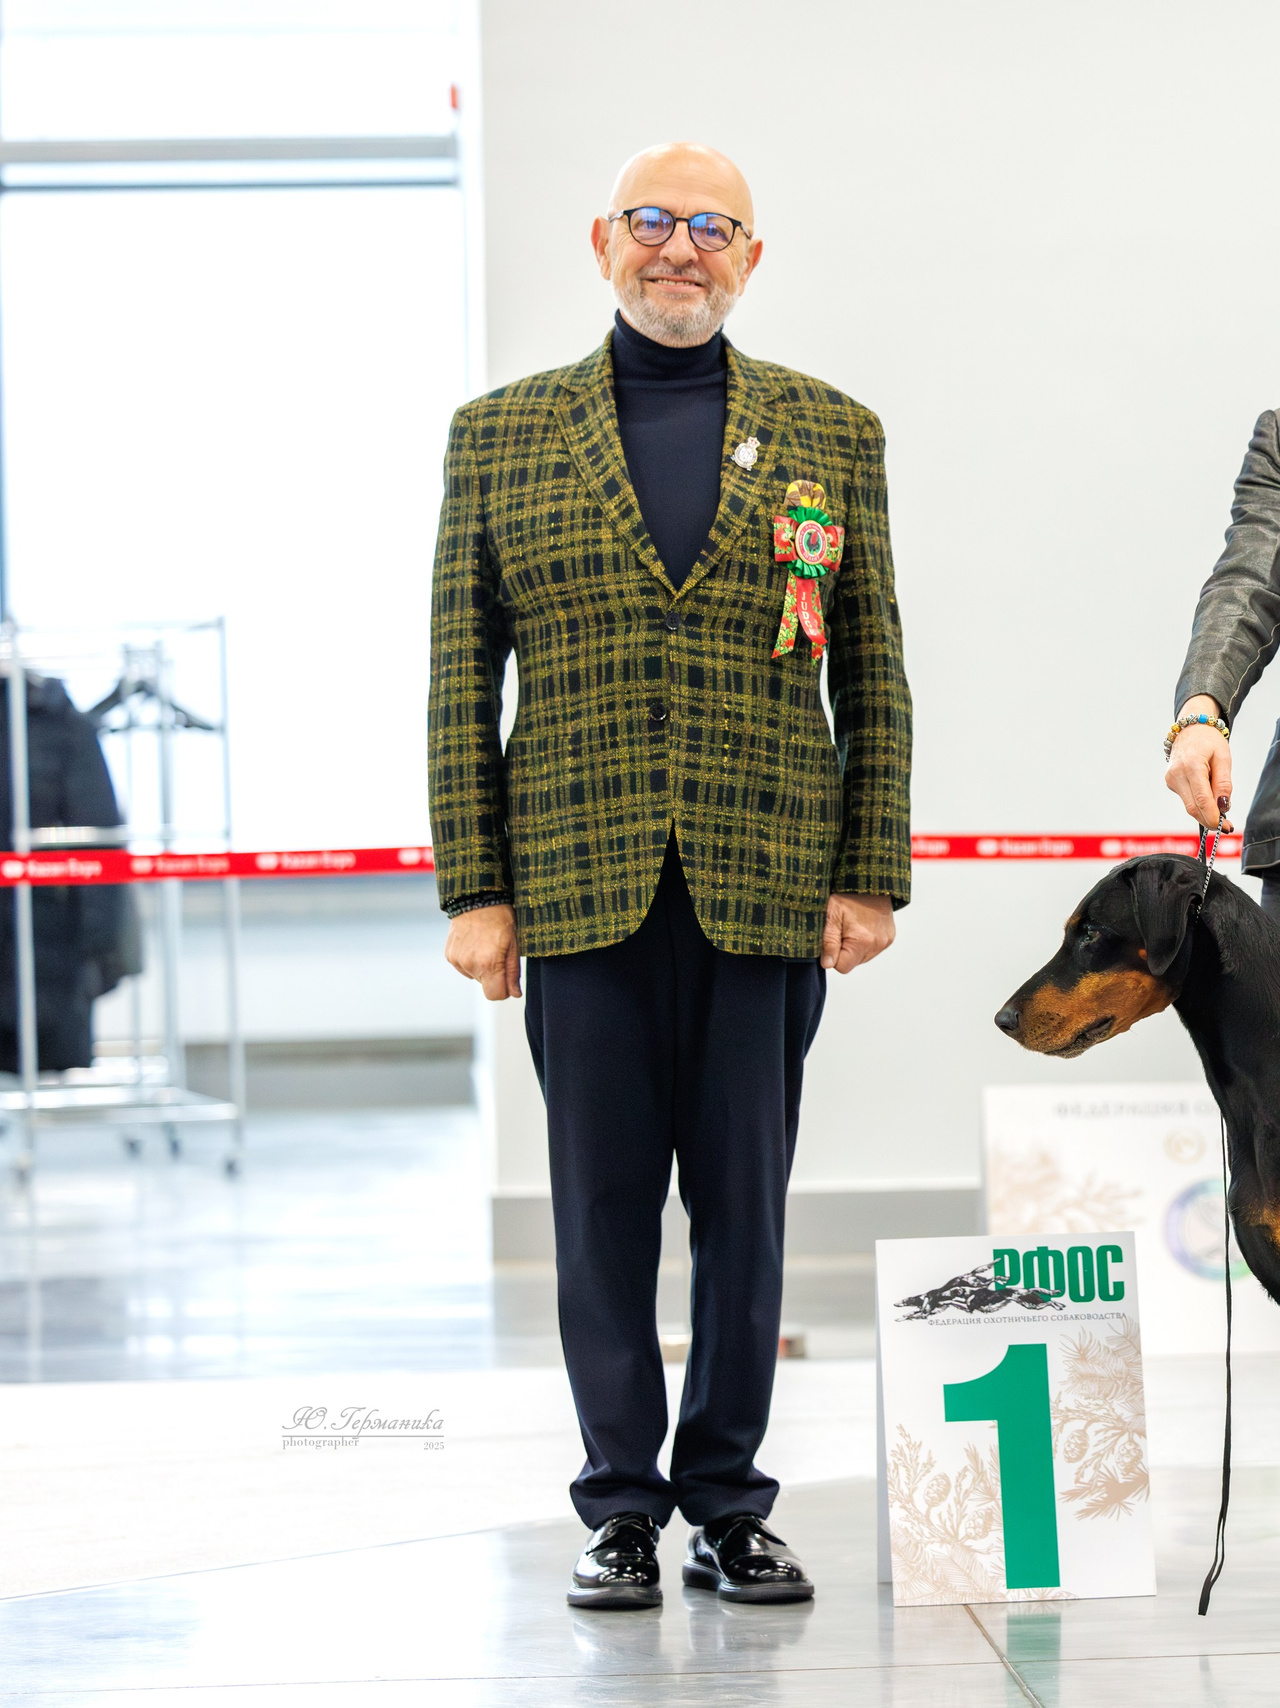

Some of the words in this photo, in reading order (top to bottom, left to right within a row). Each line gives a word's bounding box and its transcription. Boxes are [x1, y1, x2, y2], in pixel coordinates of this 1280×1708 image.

[801, 591, 817, 636] JUDGE
[993, 1244, 1126, 1304] РФОС
[927, 1316, 982, 1327] ФЕДЕРАЦИЯ
[983, 1313, 1049, 1325] ОХОТНИЧЬЕГО
[1050, 1311, 1127, 1322] СОБАКОВОДСТВА
[943, 1343, 1061, 1590] 1
